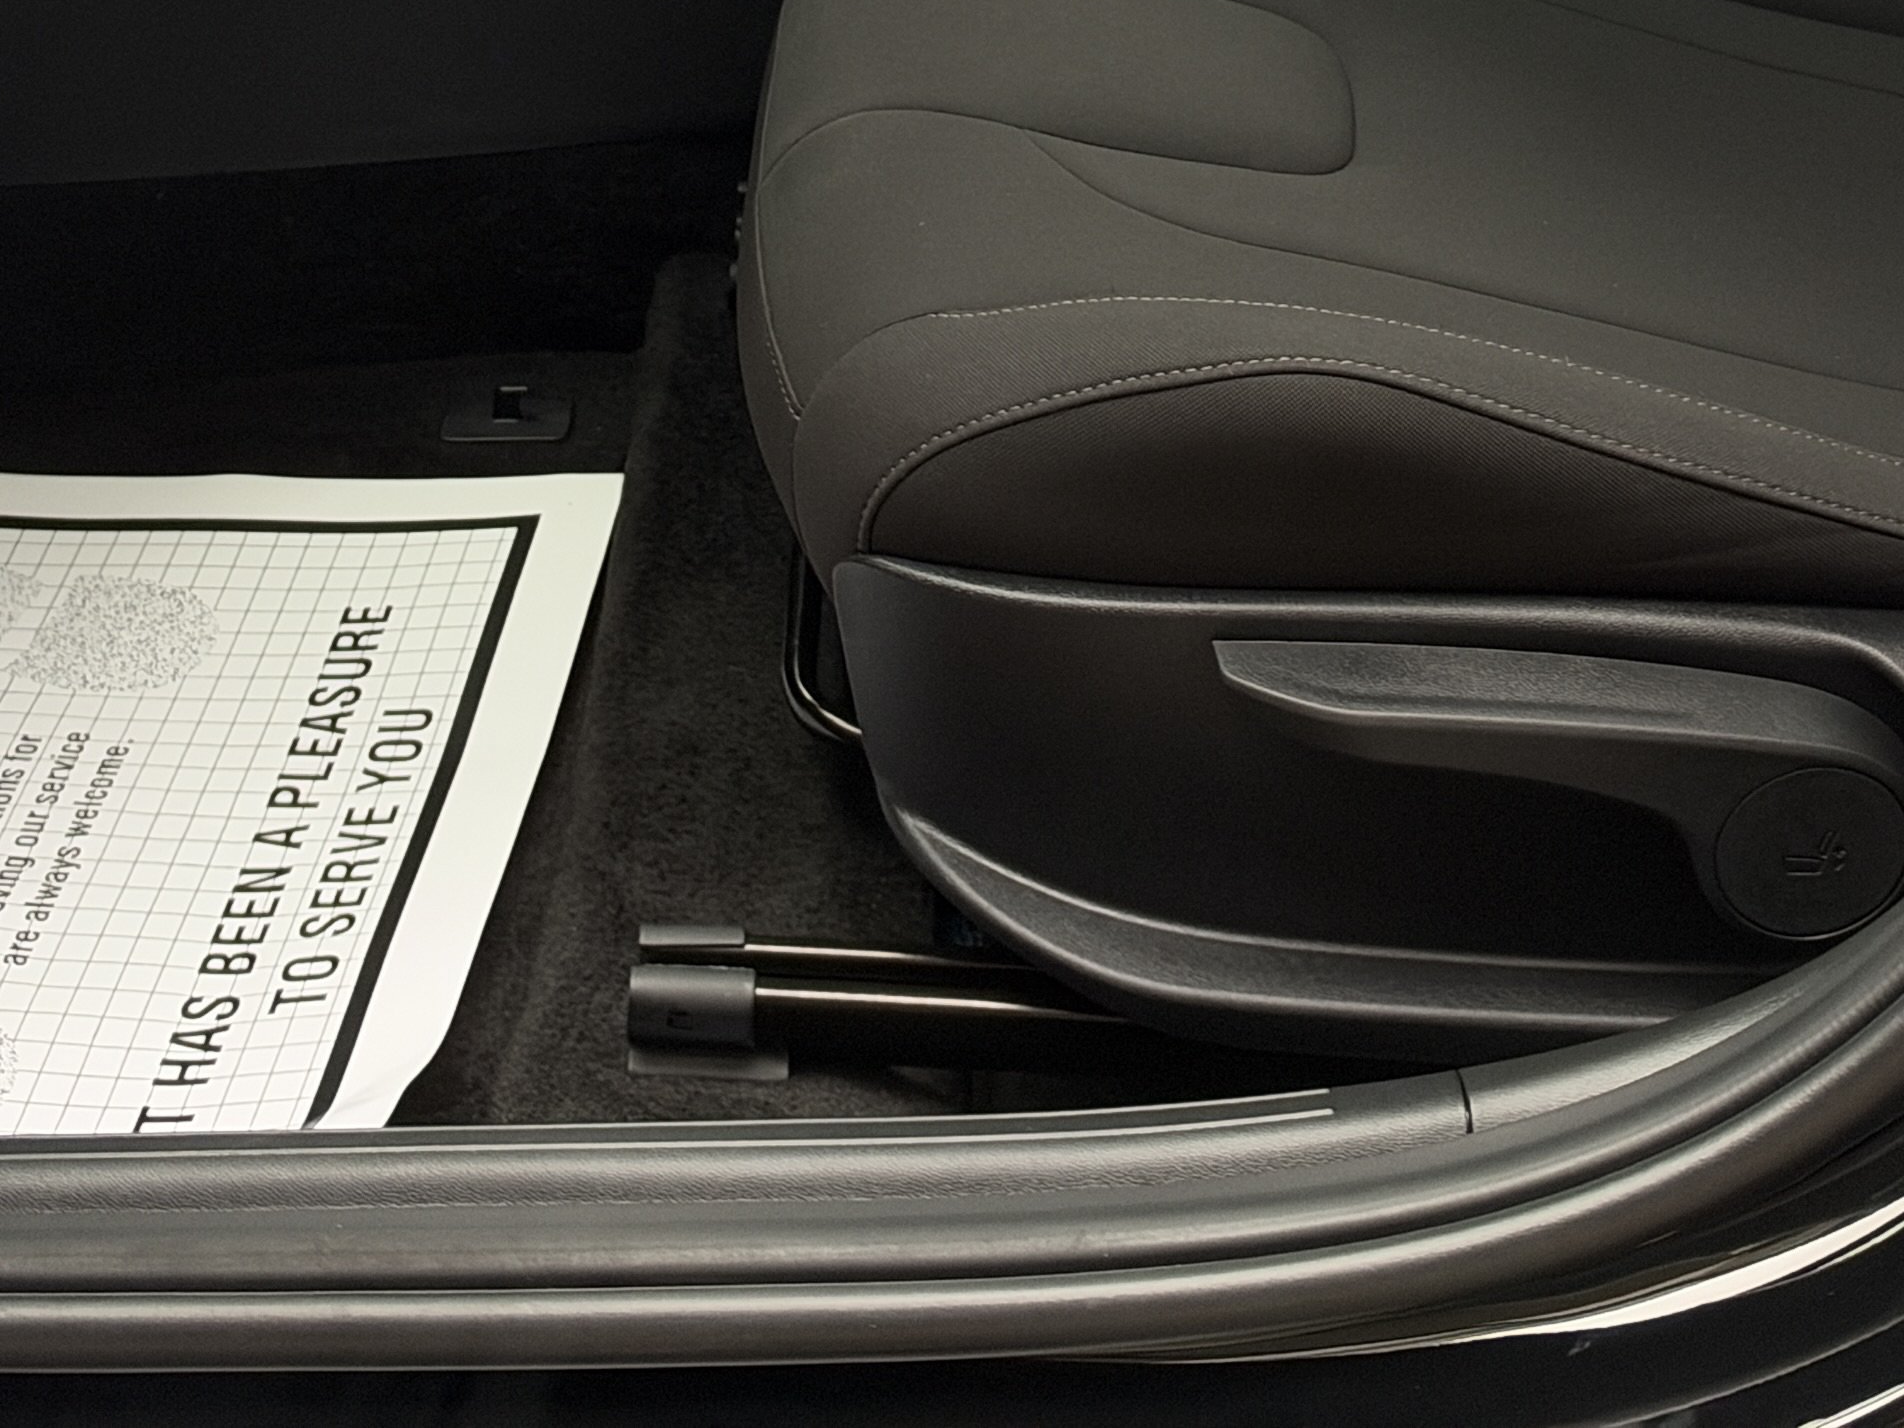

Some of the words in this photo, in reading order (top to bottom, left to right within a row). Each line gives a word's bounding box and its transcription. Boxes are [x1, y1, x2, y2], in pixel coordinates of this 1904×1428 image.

[4, 733, 43, 762] for
[266, 605, 394, 810] PLEASURE
[356, 708, 434, 794] YOU
[15, 810, 50, 847] our
[36, 732, 91, 805] service
[252, 823, 311, 849] A
[3, 930, 40, 966] are
[25, 846, 81, 922] always
[65, 738, 135, 840] welcome.
[298, 804, 400, 938] SERVE
[198, 866, 293, 976] BEEN
[268, 954, 340, 1015] TO
[153, 996, 241, 1087] HAS
